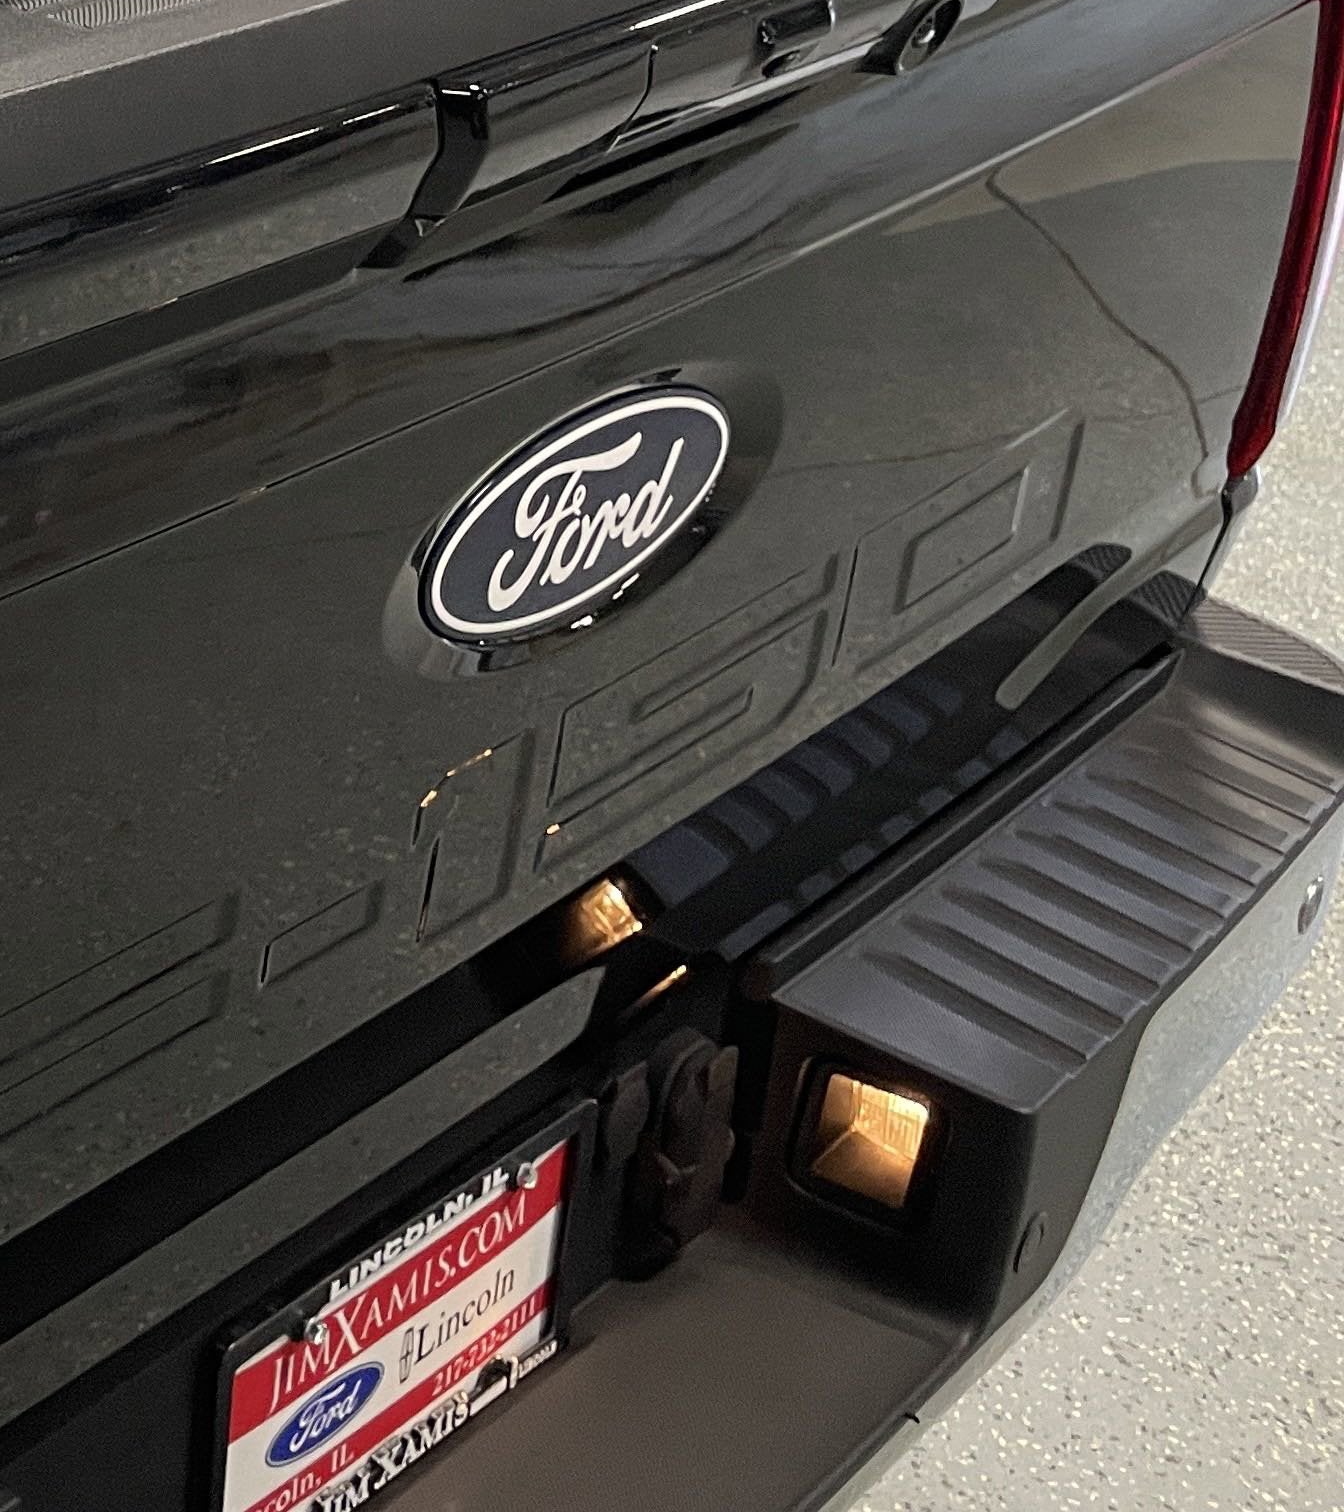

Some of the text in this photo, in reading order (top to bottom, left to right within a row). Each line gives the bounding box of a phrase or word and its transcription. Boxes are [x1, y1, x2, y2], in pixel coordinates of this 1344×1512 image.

[487, 431, 685, 612] Ford
[481, 1167, 510, 1195] IL
[413, 1269, 516, 1366] Lincoln
[288, 1379, 362, 1453] Ford
[330, 1443, 355, 1473] IL
